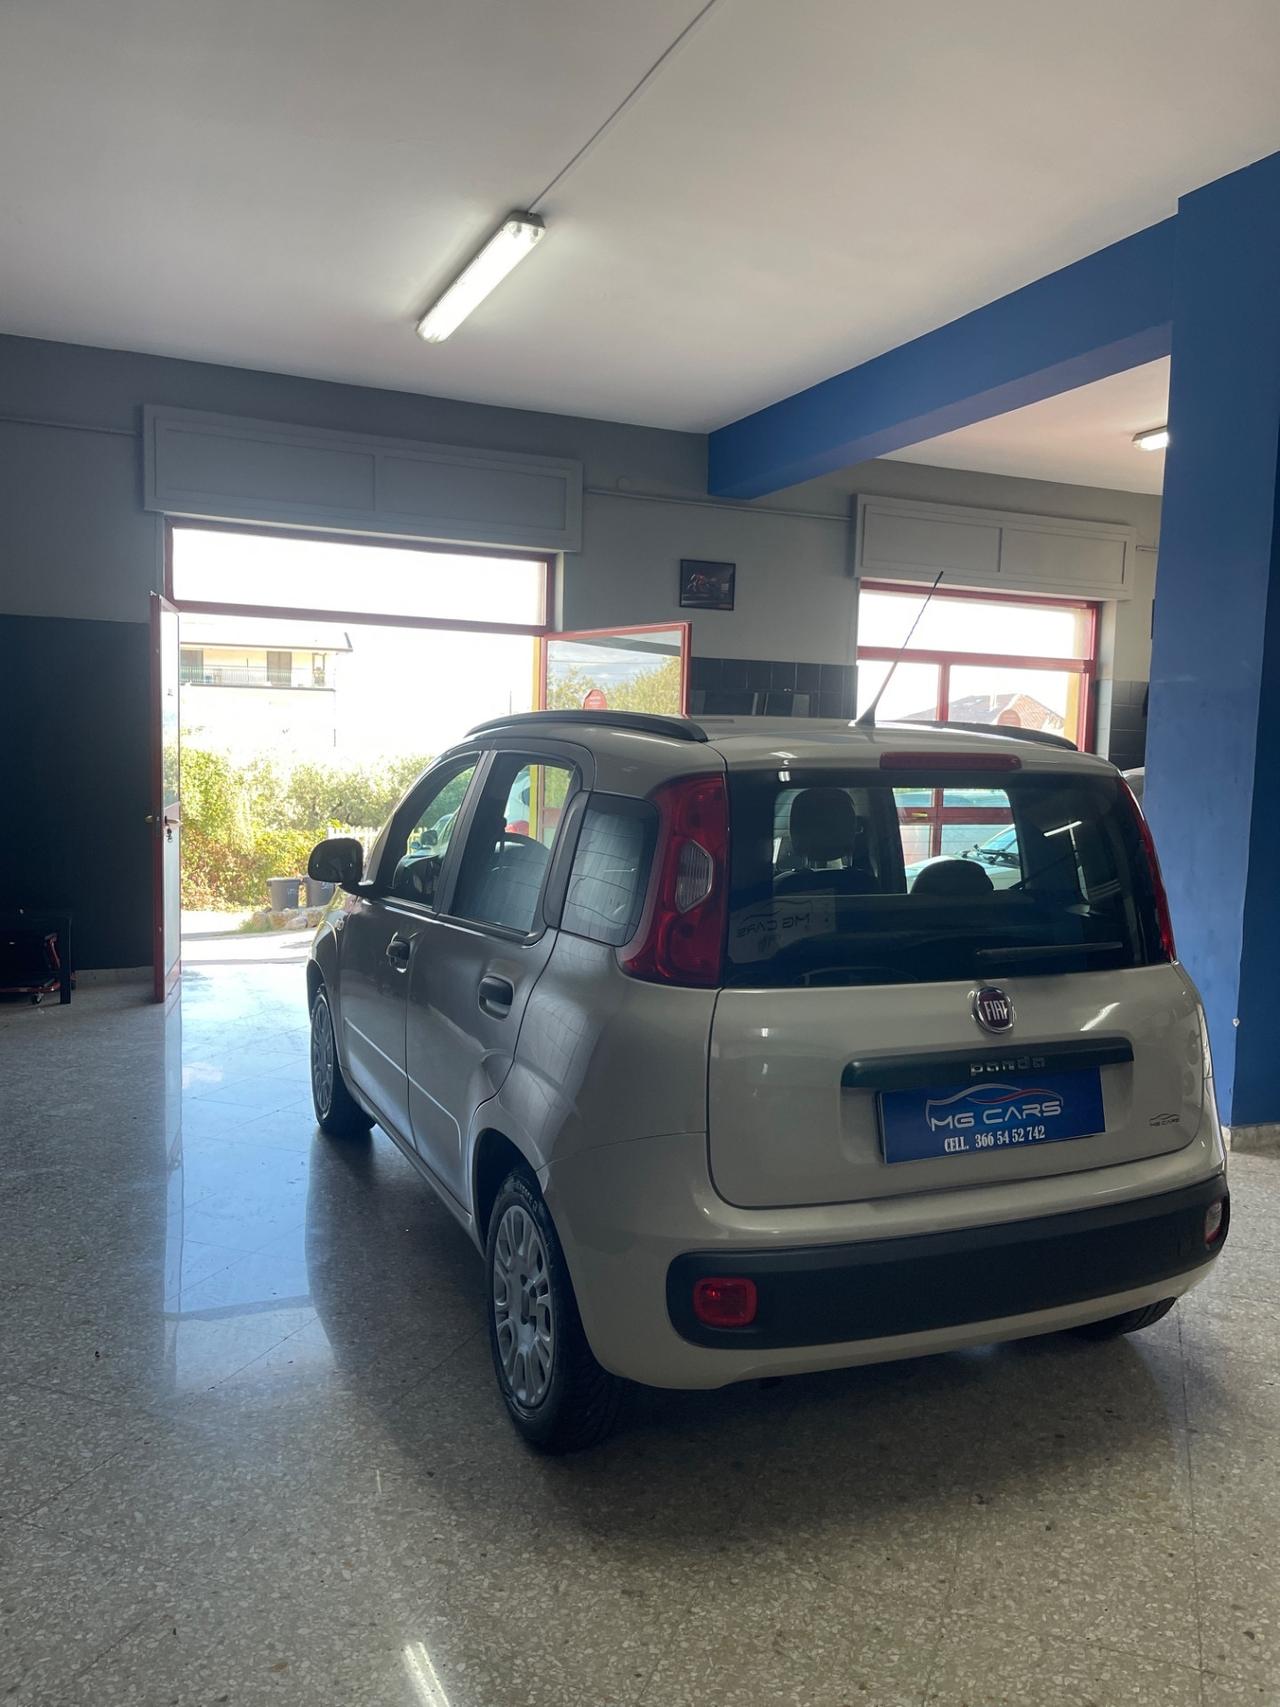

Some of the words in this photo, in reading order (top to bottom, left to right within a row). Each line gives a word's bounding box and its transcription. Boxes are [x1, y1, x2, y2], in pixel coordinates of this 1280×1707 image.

[983, 999, 1008, 1021] FIAT
[931, 1112, 974, 1132] MG
[983, 1100, 1061, 1124] CARS
[944, 1136, 969, 1152] CELL.
[975, 1131, 994, 1148] 366
[996, 1130, 1010, 1145] 54
[1012, 1128, 1025, 1143] 52
[1027, 1125, 1045, 1140] 742
